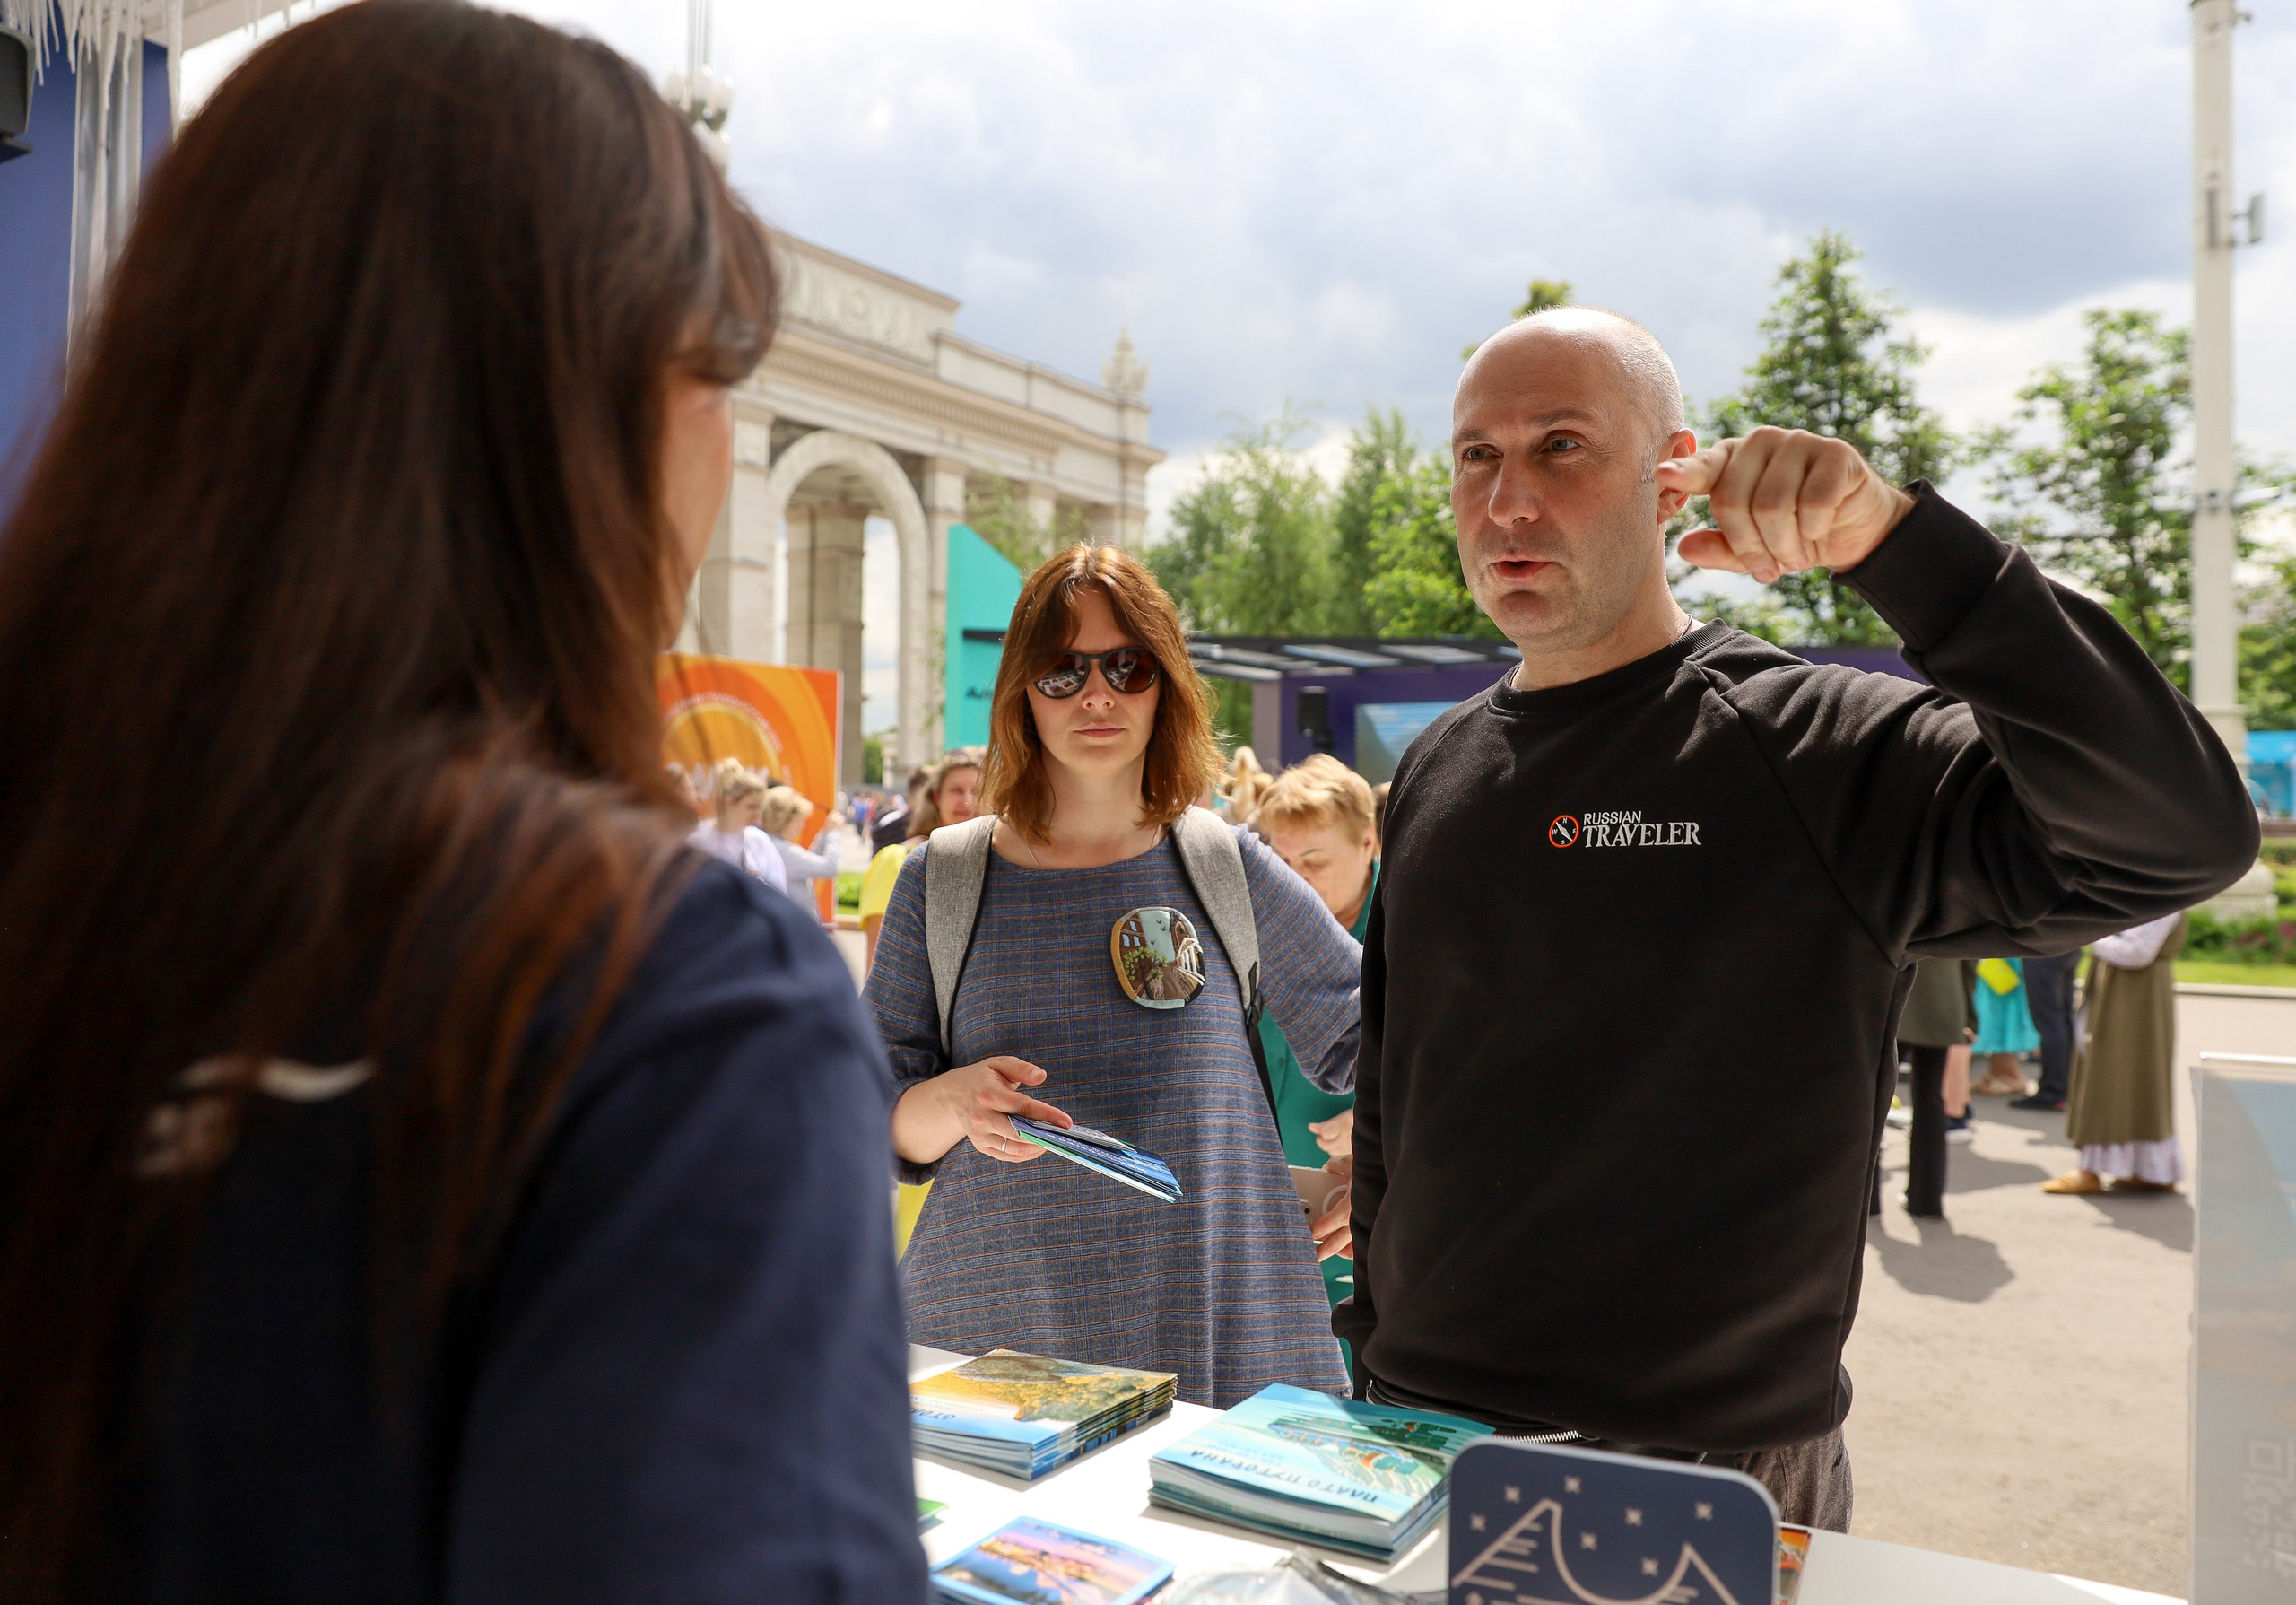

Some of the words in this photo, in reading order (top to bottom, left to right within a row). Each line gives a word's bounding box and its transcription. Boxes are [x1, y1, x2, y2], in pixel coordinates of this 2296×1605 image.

[1583, 811, 1641, 825] RUSSIAN
[1582, 822, 1702, 848] TRAVELER
[1191, 1450, 1300, 1483] ПУТОРАНА
[1307, 1479, 1379, 1503] ПЛАТО
